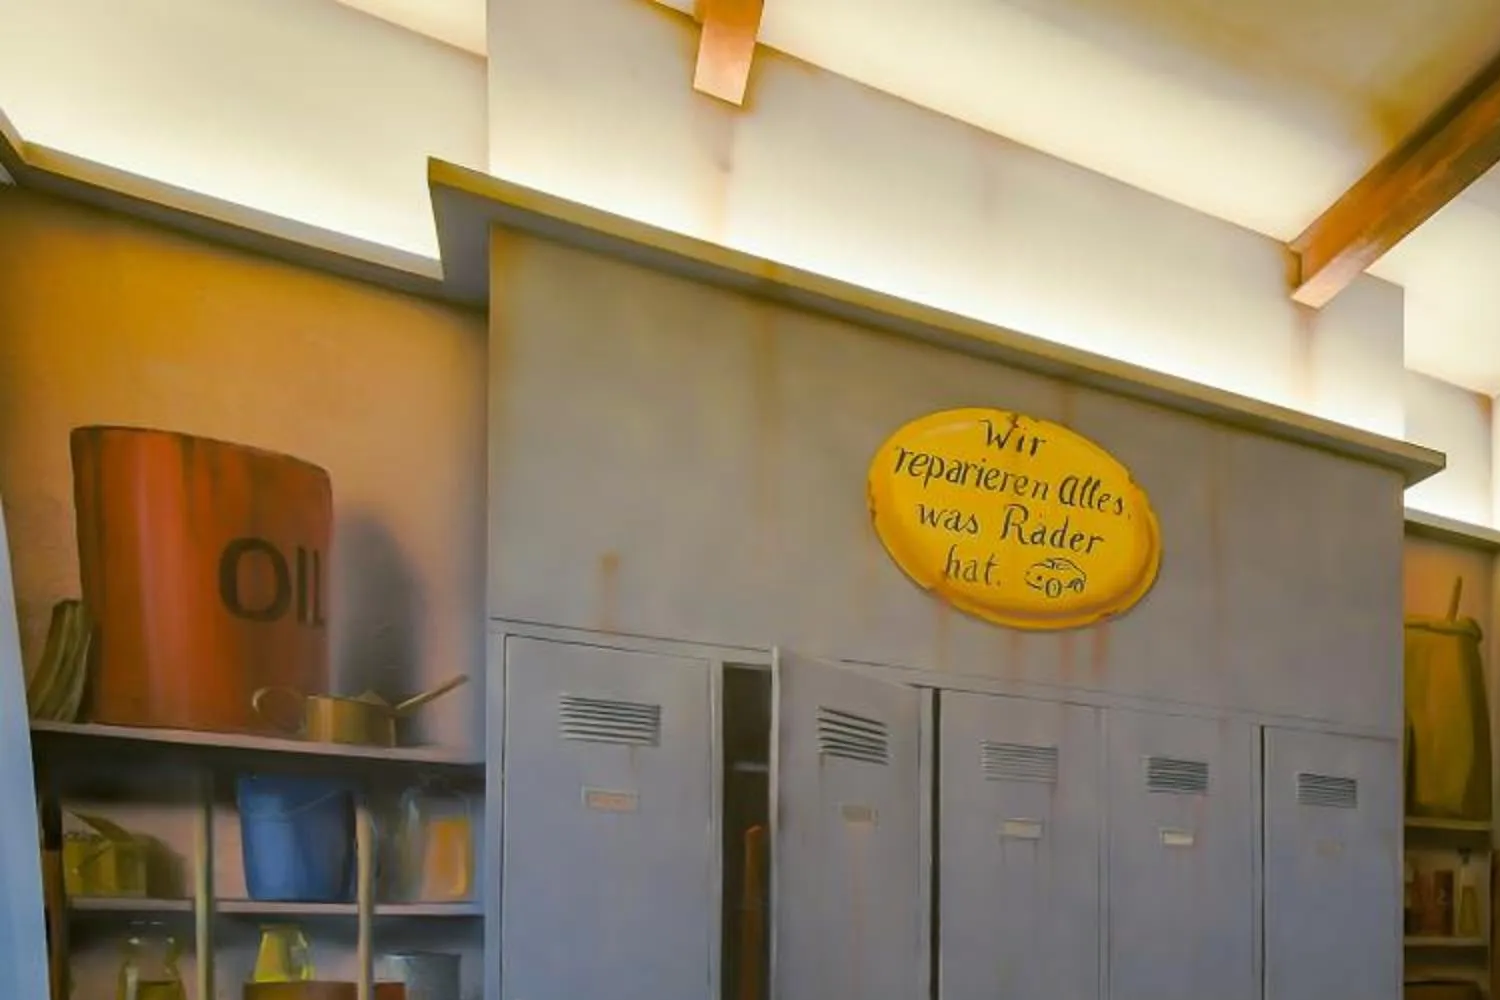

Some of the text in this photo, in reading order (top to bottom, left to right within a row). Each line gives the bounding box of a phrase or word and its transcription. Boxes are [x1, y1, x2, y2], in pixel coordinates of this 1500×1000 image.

[978, 413, 1048, 457] Wir
[895, 446, 1049, 500] reparieren
[917, 502, 980, 535] was
